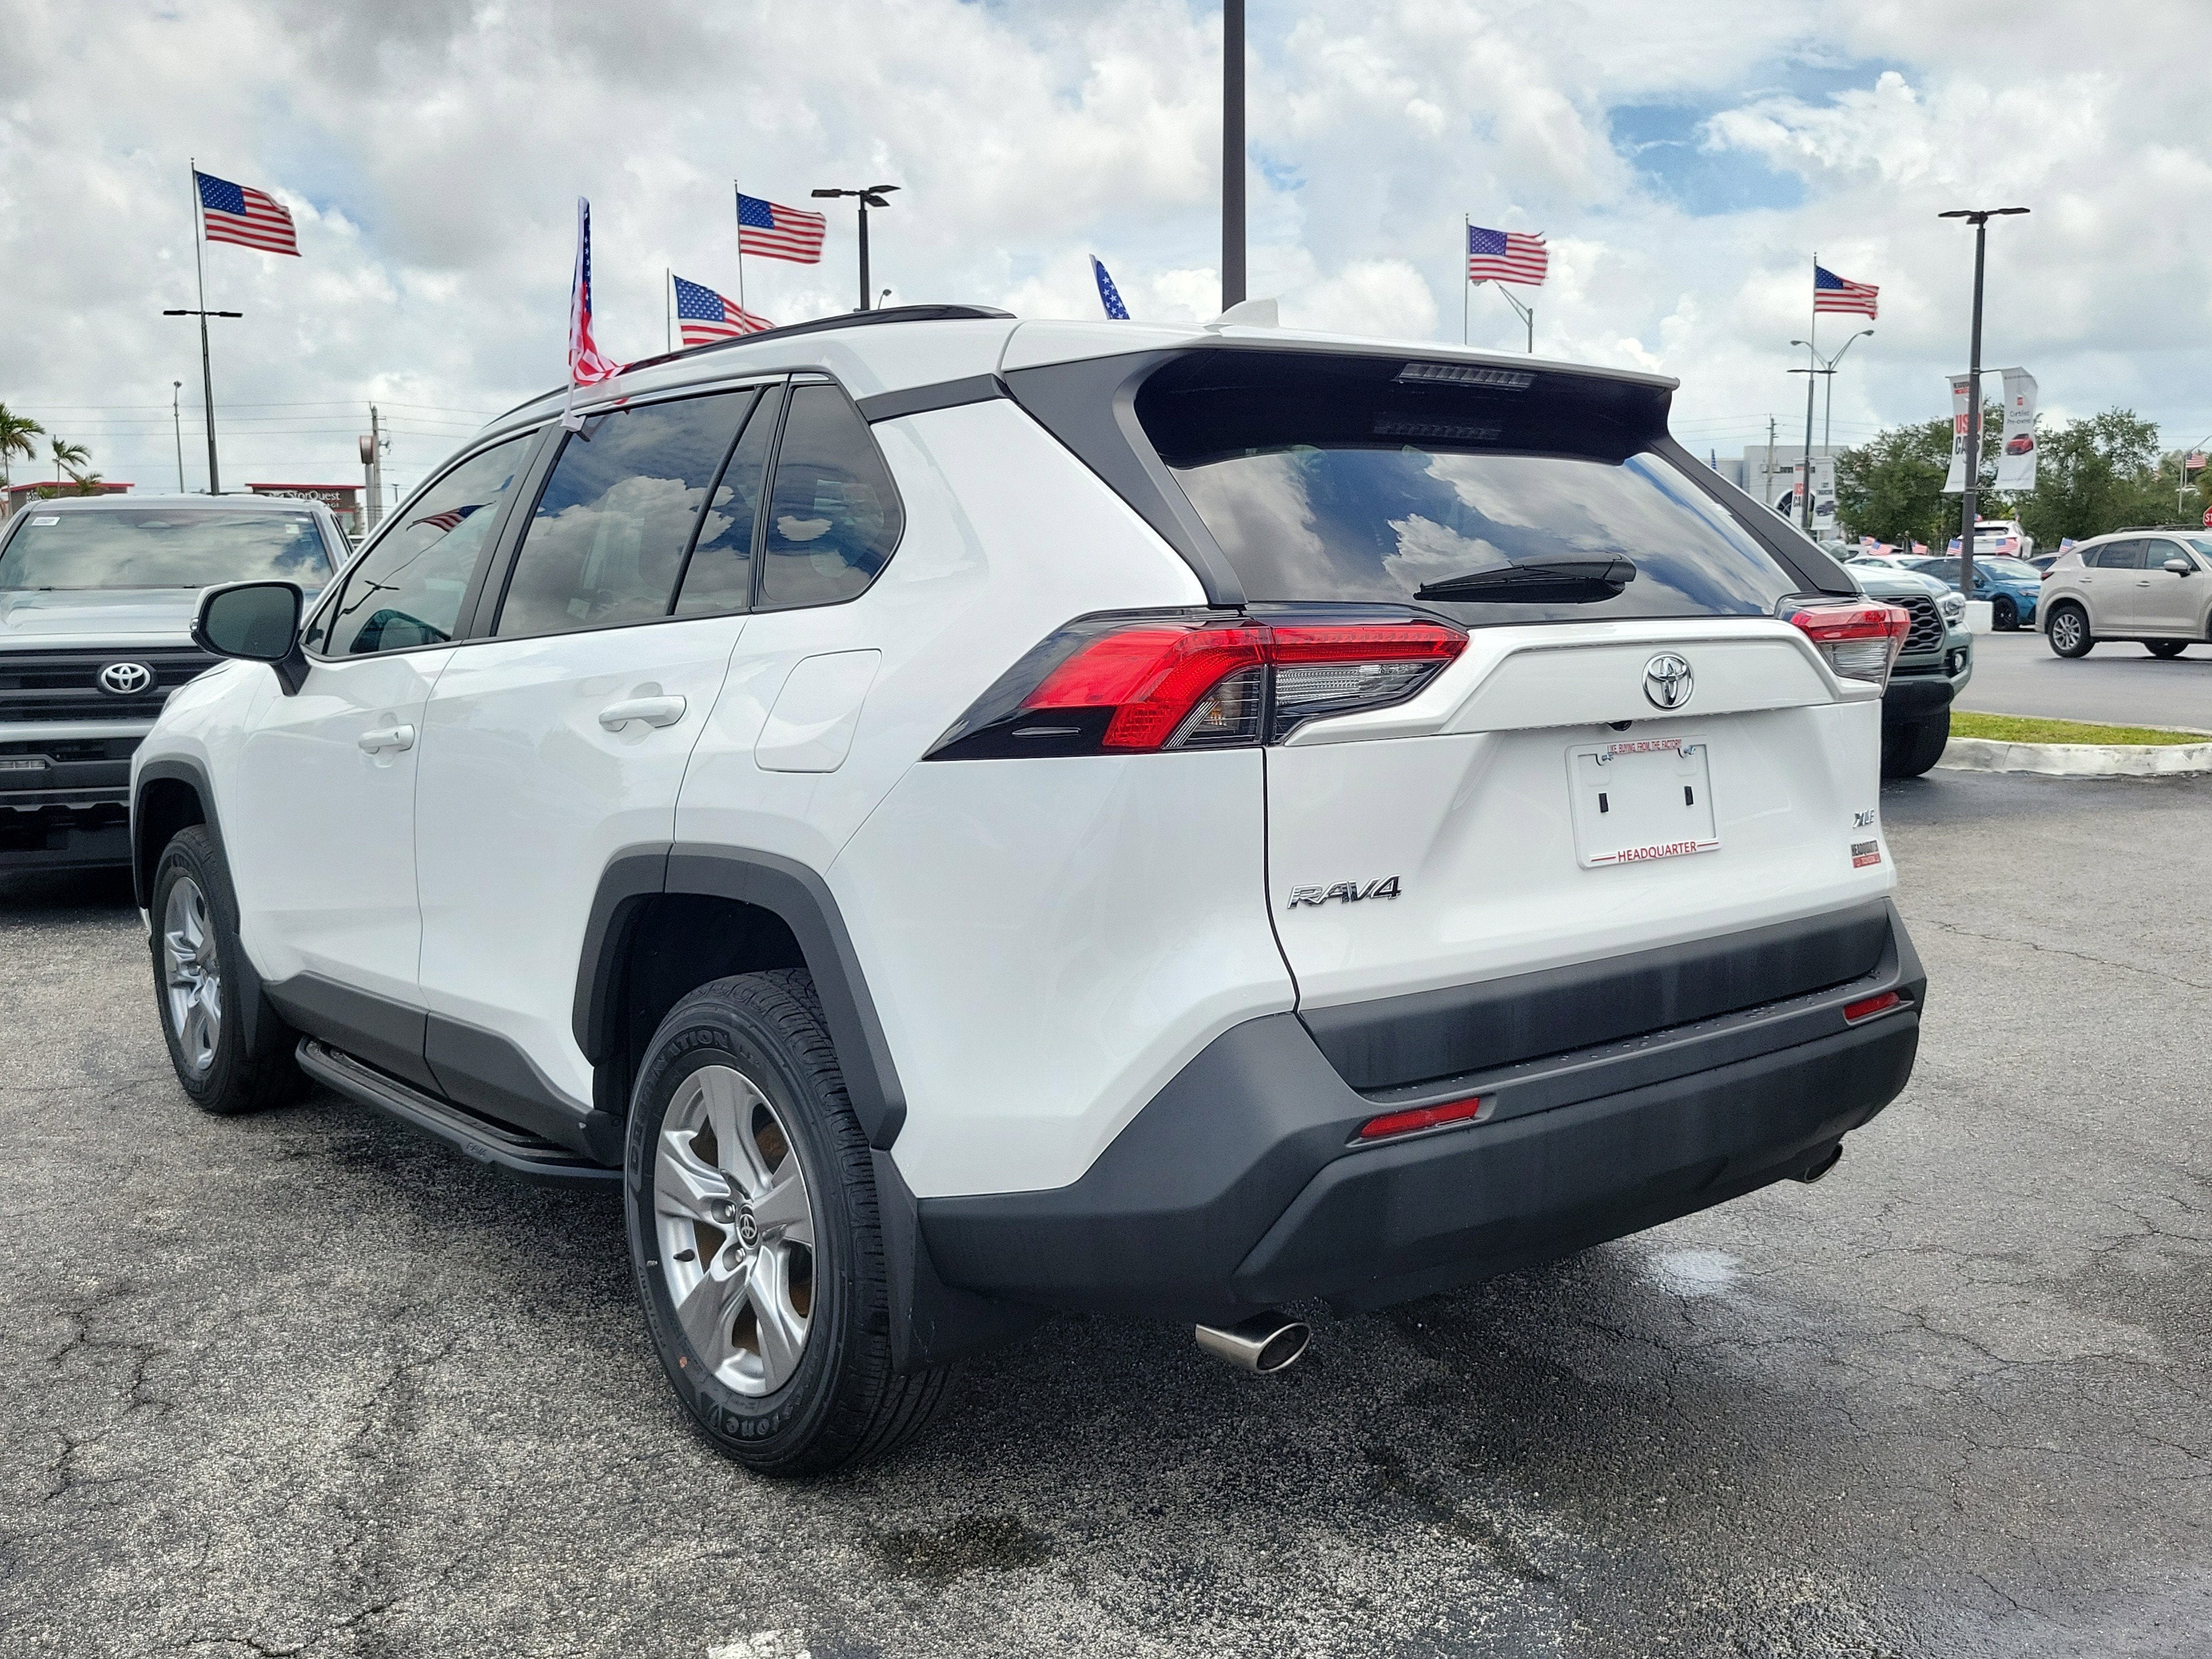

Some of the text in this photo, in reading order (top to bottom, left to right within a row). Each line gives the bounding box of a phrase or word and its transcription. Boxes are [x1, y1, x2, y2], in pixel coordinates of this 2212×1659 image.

[1638, 742, 1650, 752] FROM
[1618, 841, 1697, 862] HEADQUARTER
[1287, 874, 1403, 909] RAV4
